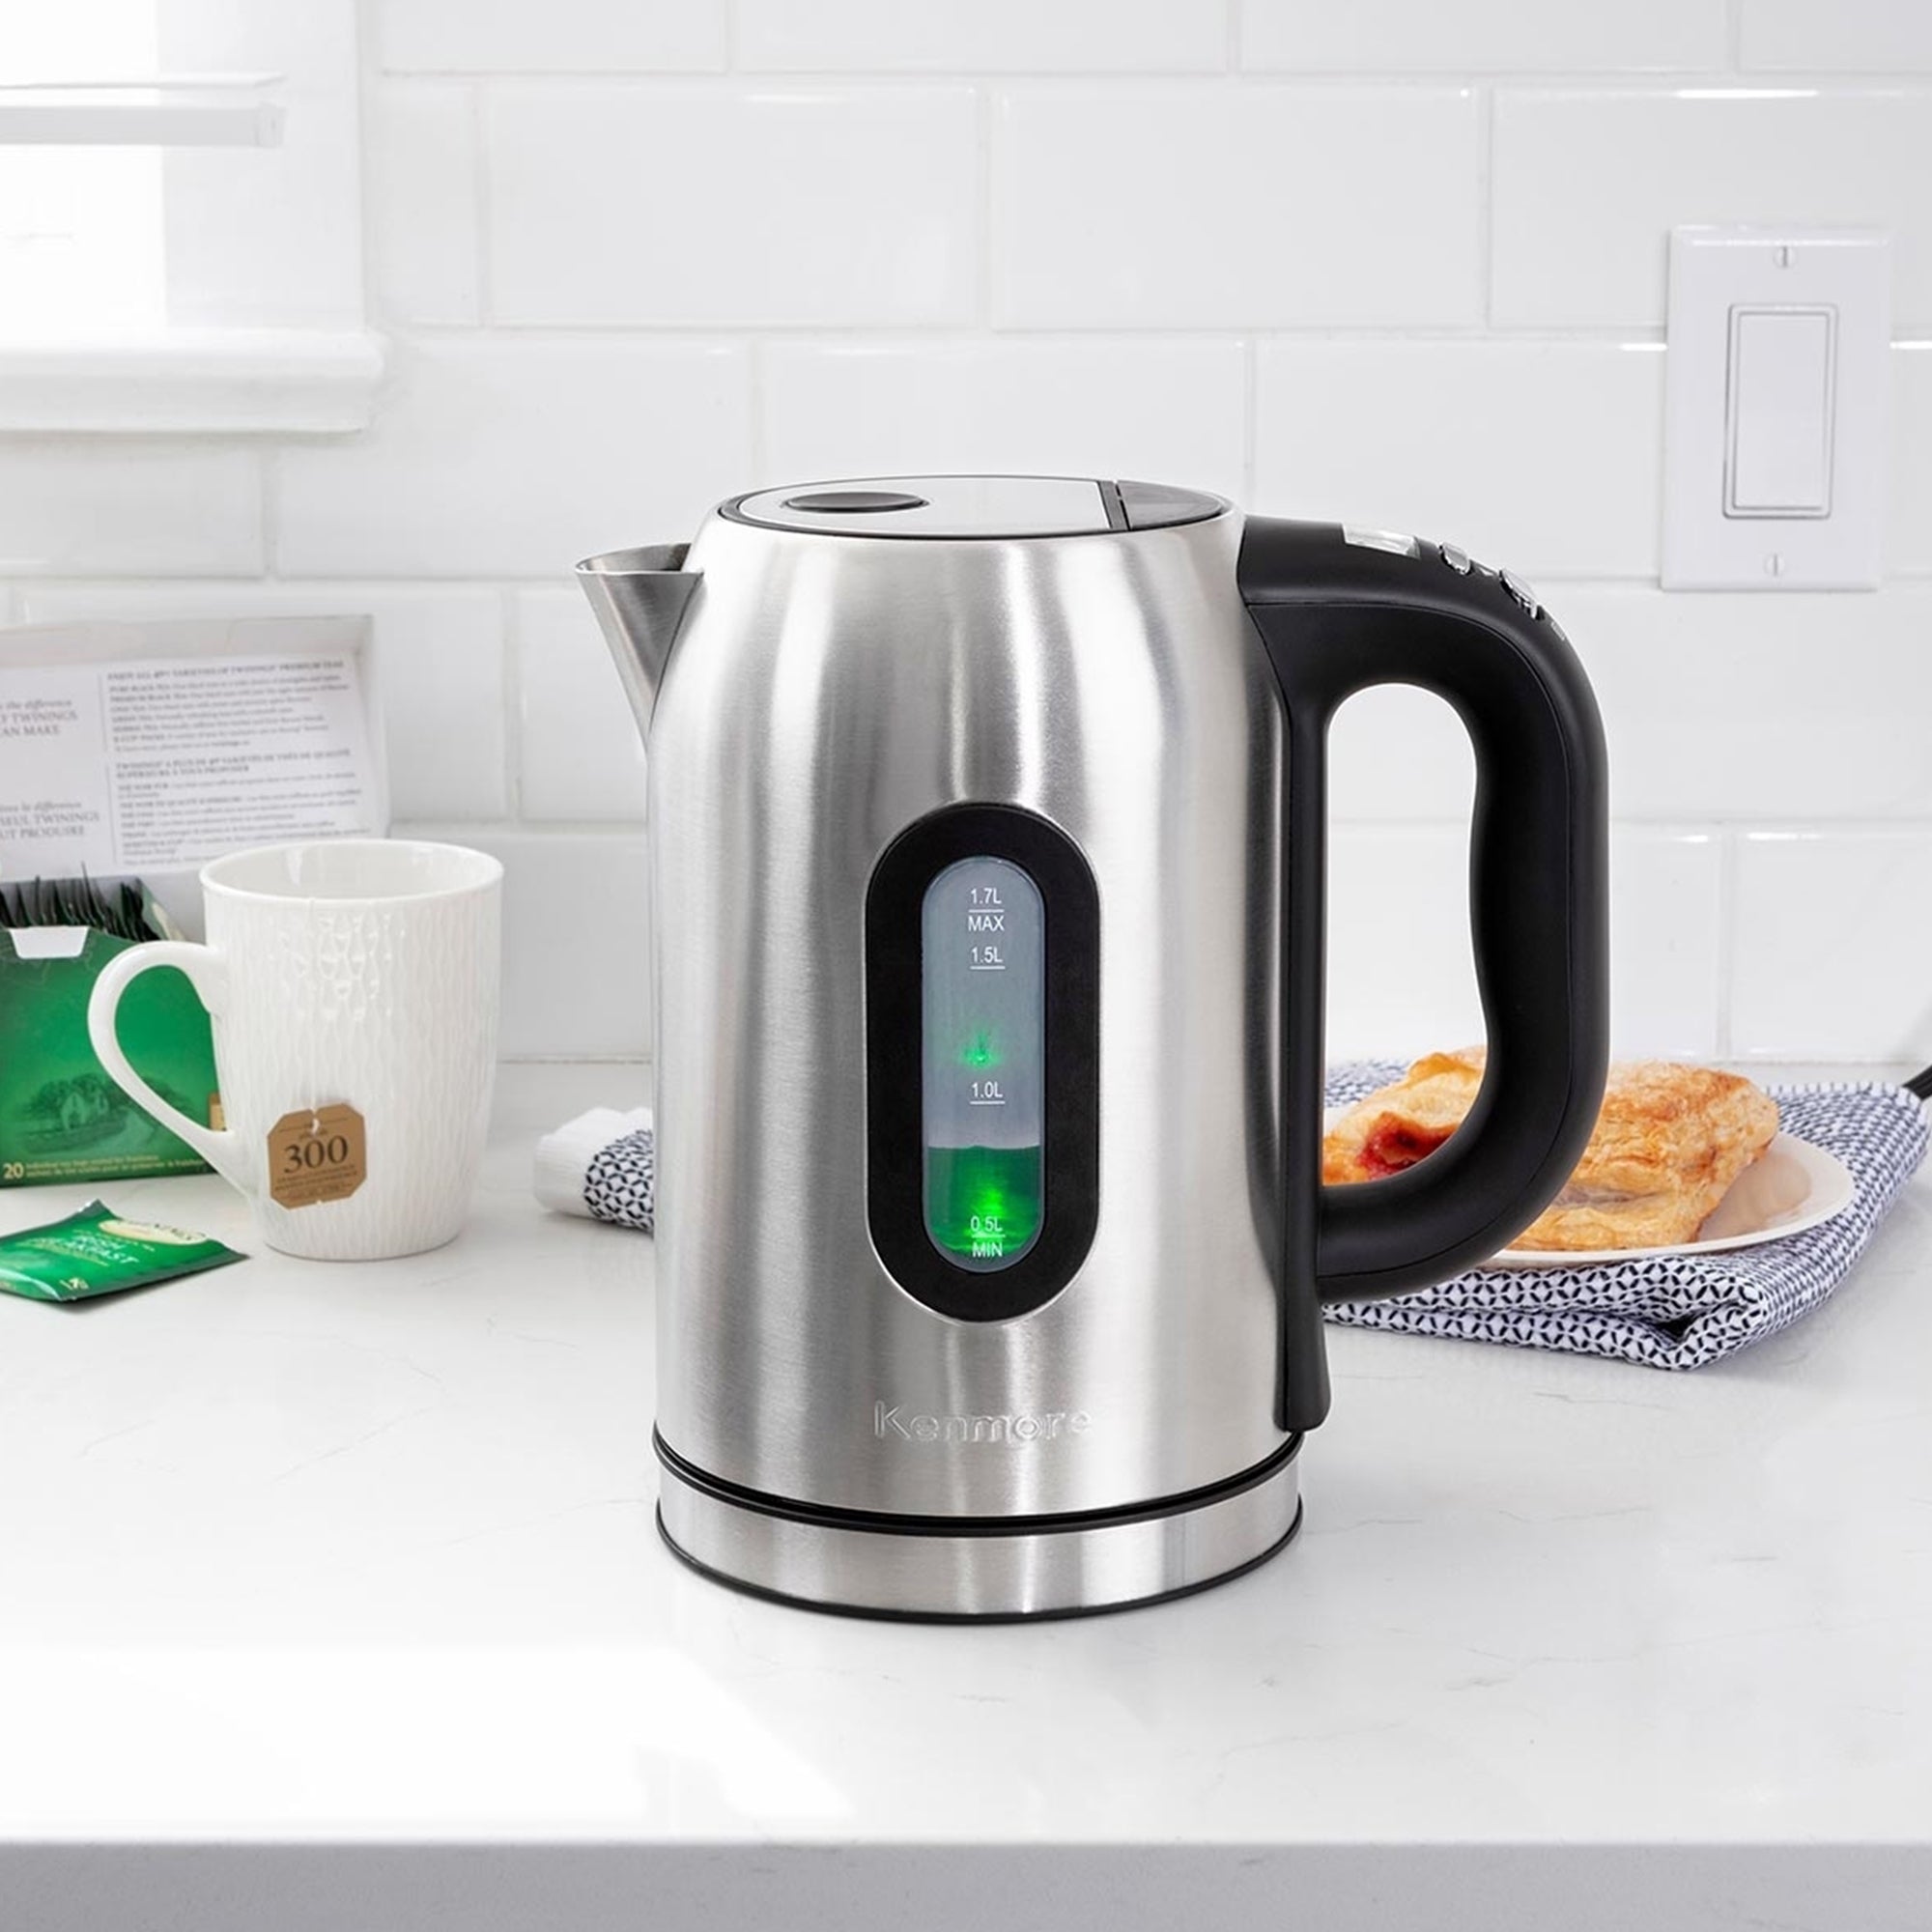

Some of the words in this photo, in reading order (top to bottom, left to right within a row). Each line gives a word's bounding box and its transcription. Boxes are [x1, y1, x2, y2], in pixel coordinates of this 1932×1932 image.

[11, 710, 78, 724] TWININGS
[971, 888, 1002, 904] 1.7L
[968, 915, 1005, 931] MAX
[972, 947, 1004, 963] 1.5L
[972, 1081, 1004, 1098] 1.0L
[284, 1135, 349, 1174] 300
[3, 1161, 24, 1179] 20
[970, 1215, 1004, 1233] 05L
[972, 1241, 1003, 1258] MIN
[873, 1400, 1093, 1444] Kenmore
